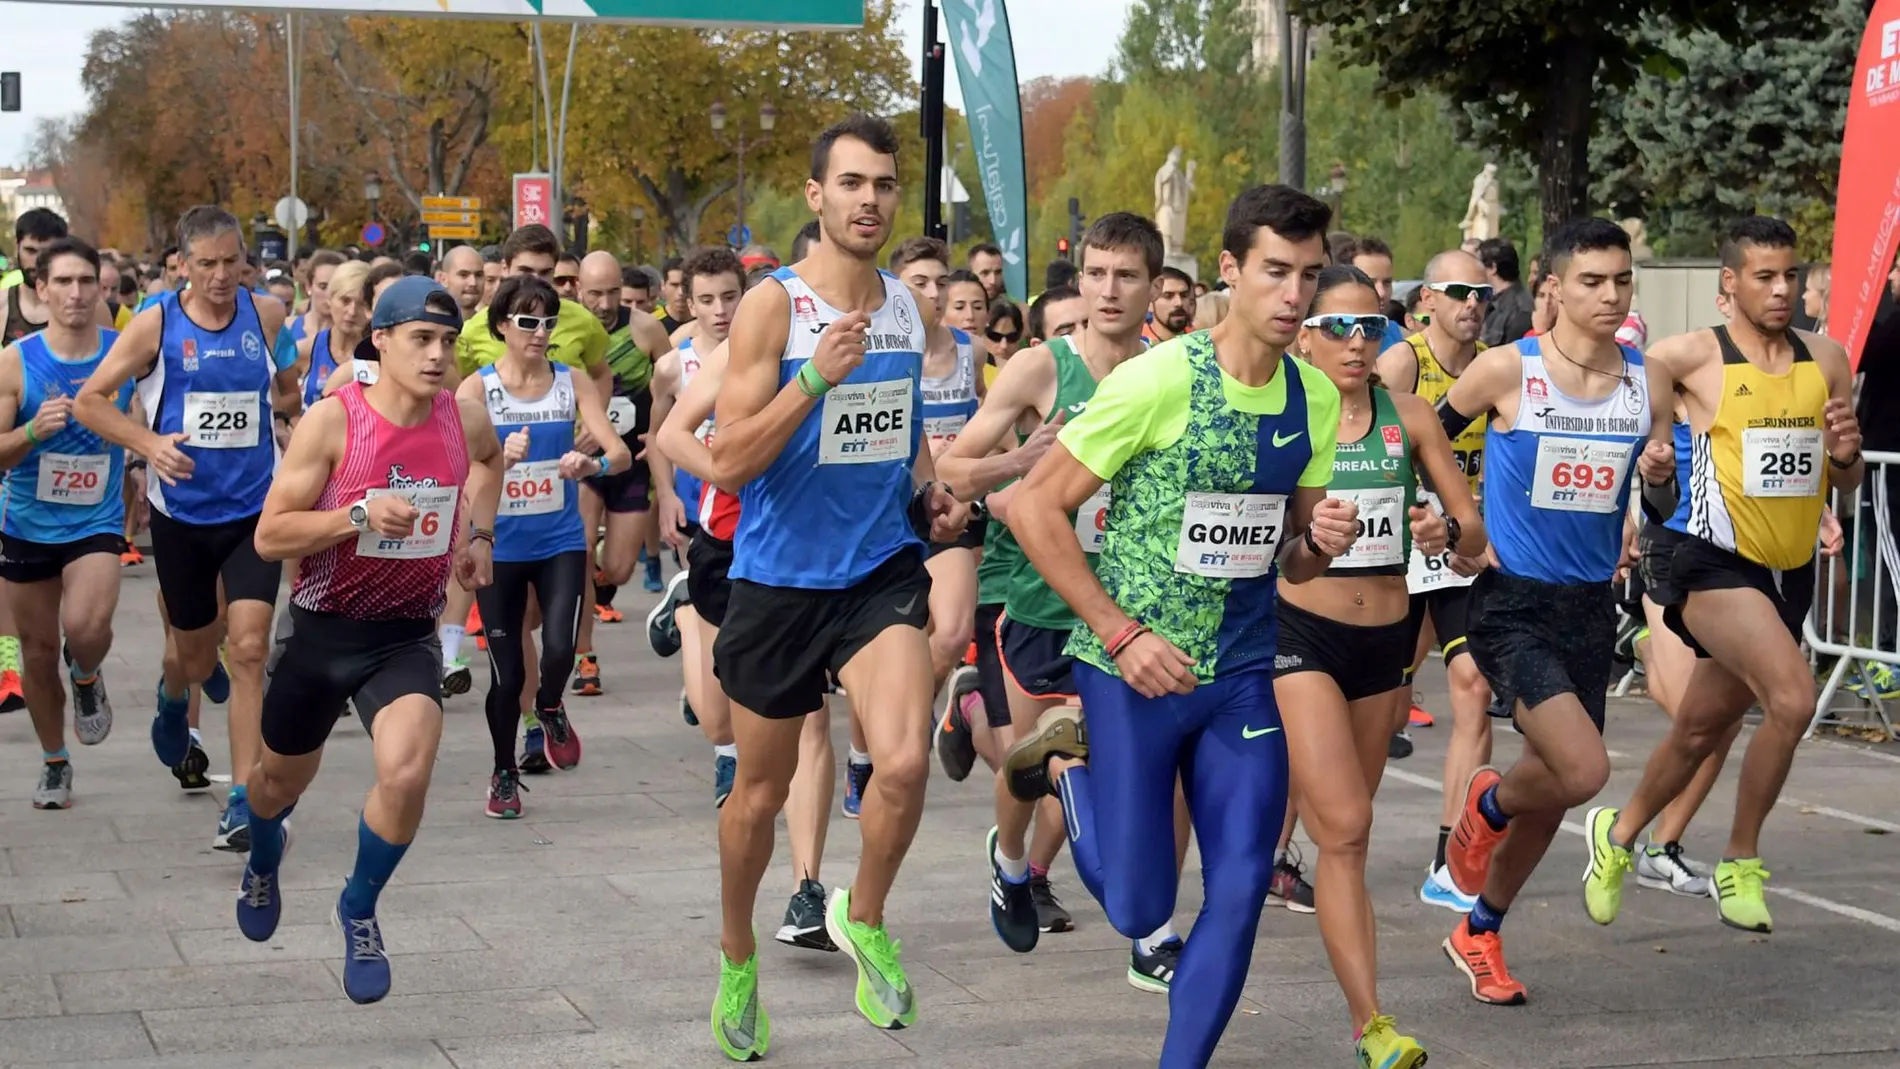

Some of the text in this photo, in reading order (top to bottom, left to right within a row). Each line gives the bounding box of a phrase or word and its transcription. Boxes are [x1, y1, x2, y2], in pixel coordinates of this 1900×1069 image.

[1867, 64, 1886, 93] DE
[199, 412, 248, 430] 228
[609, 411, 620, 423] 2
[833, 408, 904, 435] ARCE
[1545, 415, 1639, 433] UNIVERSIDAD DE BURGOS
[1764, 417, 1815, 428] RUNNERS
[1760, 452, 1812, 475] 285
[52, 470, 98, 489] 720
[1552, 462, 1614, 490] 693
[506, 478, 553, 498] 604
[1191, 500, 1279, 513] cajaviva cajarural
[1188, 523, 1276, 545] GOMEZ
